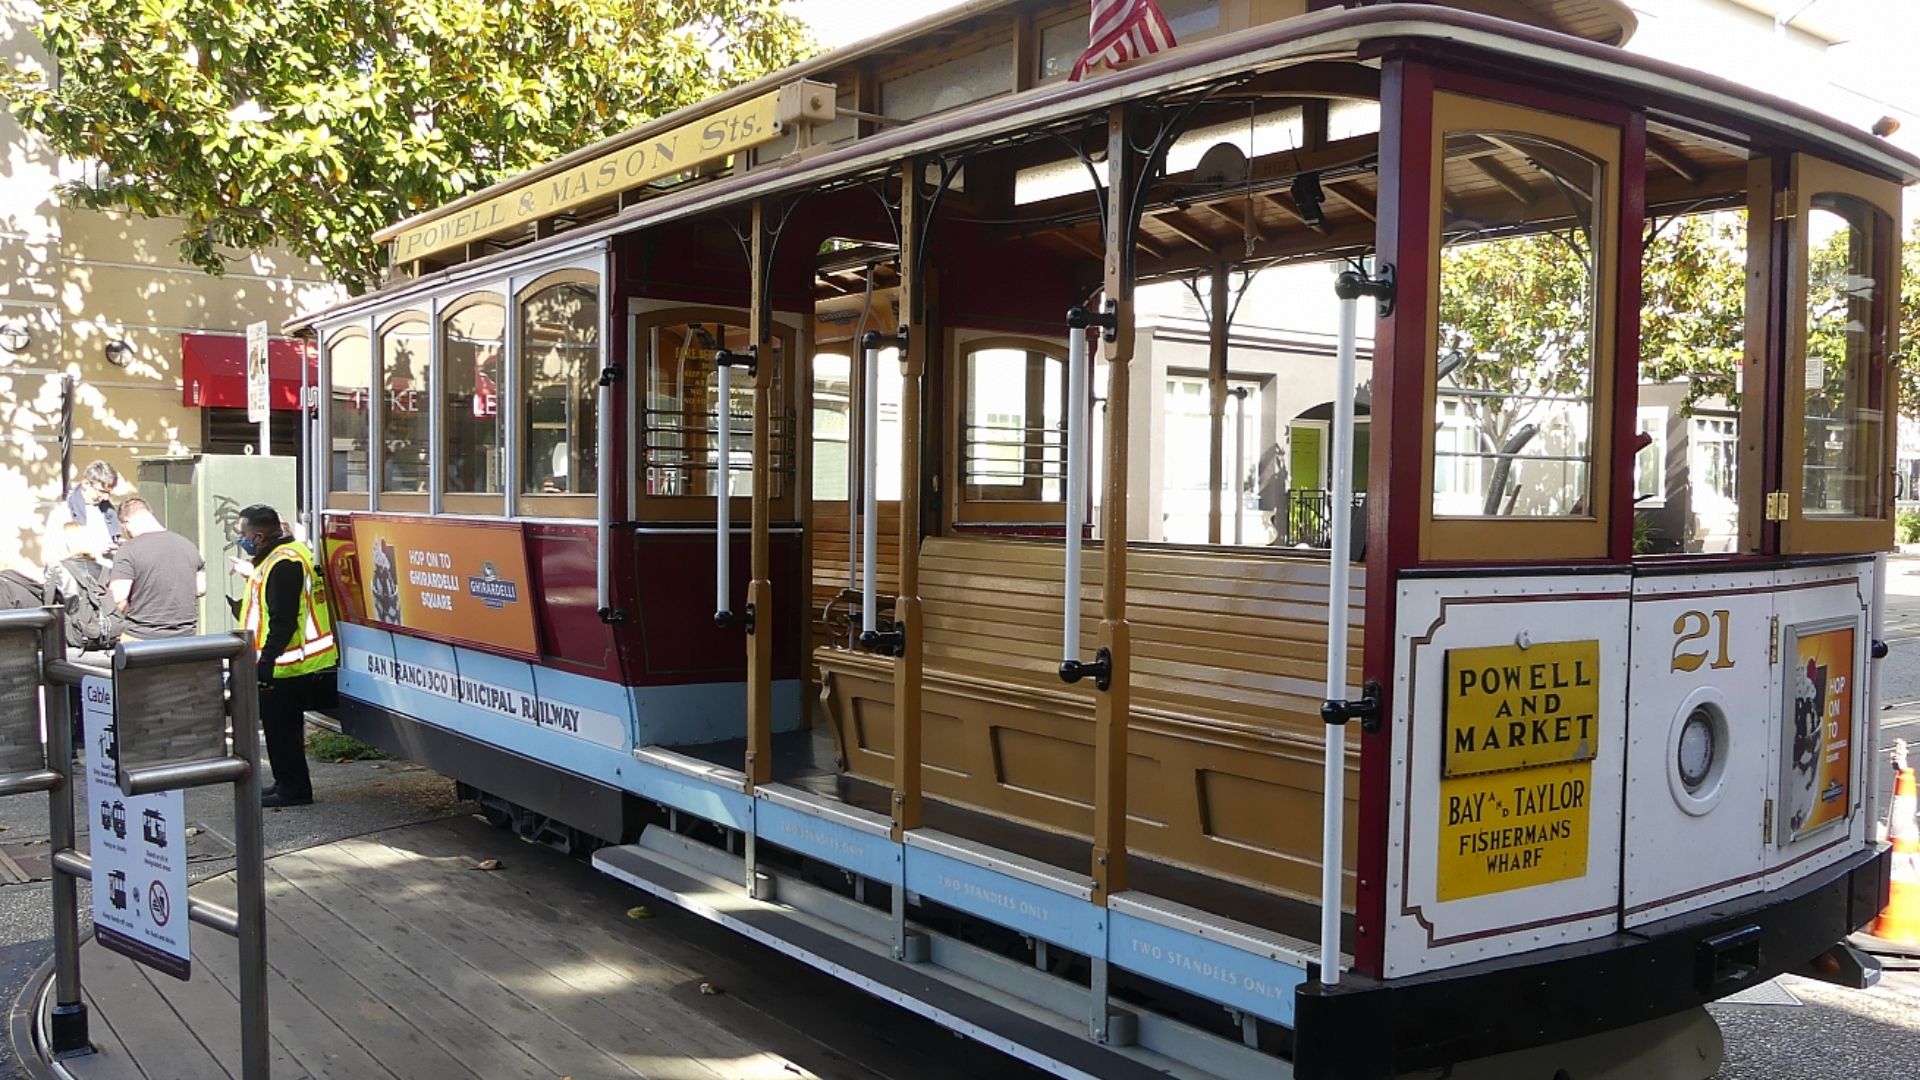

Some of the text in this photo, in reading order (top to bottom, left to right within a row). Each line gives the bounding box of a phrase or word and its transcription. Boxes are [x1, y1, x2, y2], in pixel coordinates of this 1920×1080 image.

[406, 112, 763, 254] POWELL & MASON Sts.
[409, 550, 451, 569] HOP ON TO
[410, 571, 460, 592] GHIRARDELLI
[470, 580, 516, 599] GHIRARDELLI
[421, 591, 453, 611] SQUARE
[1670, 609, 1736, 674] 21
[1459, 661, 1591, 697] POWELL
[1828, 676, 1846, 696] HOP
[87, 685, 111, 705] Cable
[367, 654, 387, 676] SAN
[450, 677, 517, 714] MUNICIPAL
[521, 696, 580, 733] RAILWAY
[1496, 695, 1561, 719] AND
[1828, 703, 1841, 718] ON
[1454, 714, 1594, 754] MARKET
[1827, 723, 1838, 739] TO
[1448, 780, 1584, 826] BAY AND TAYLOR
[1459, 819, 1571, 856] FISHERMANS
[1486, 848, 1544, 874] WHARF
[938, 874, 1049, 920] TWO STANDEES ONLY
[1132, 939, 1283, 999] TWO STANDEES ONLY
